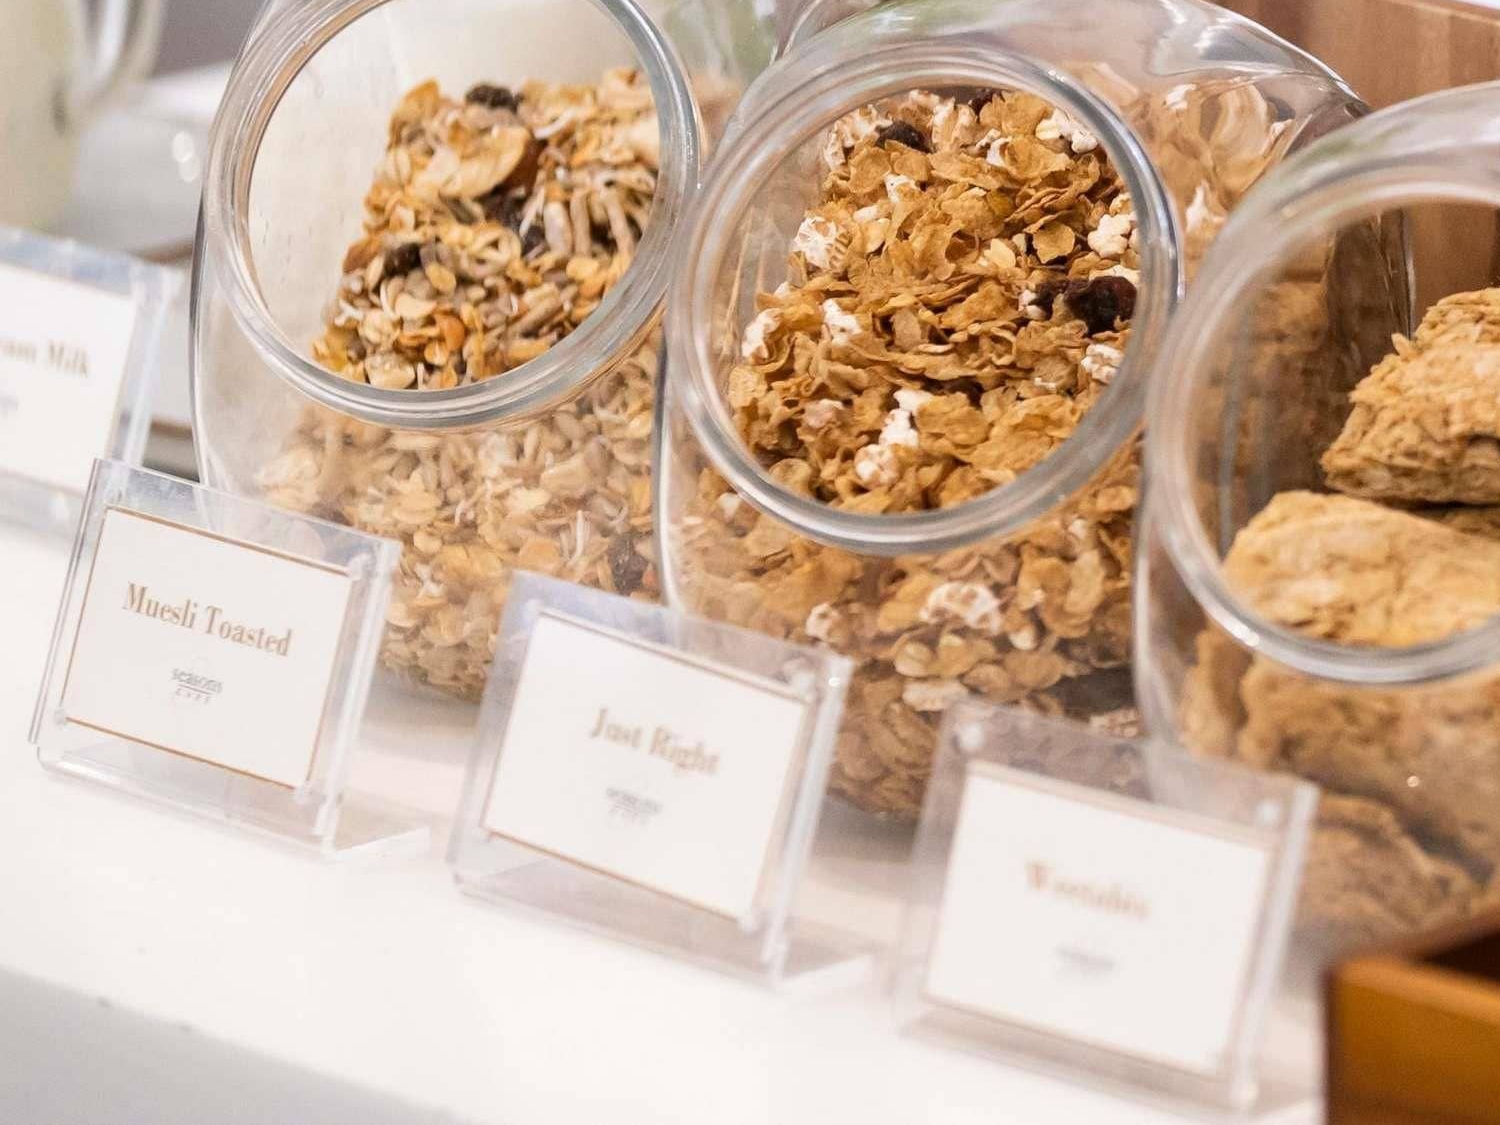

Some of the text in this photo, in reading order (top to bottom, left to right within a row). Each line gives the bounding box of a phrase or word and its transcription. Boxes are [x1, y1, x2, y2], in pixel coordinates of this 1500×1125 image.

[122, 581, 293, 657] Muesli Toasted
[588, 707, 720, 776] Just Right
